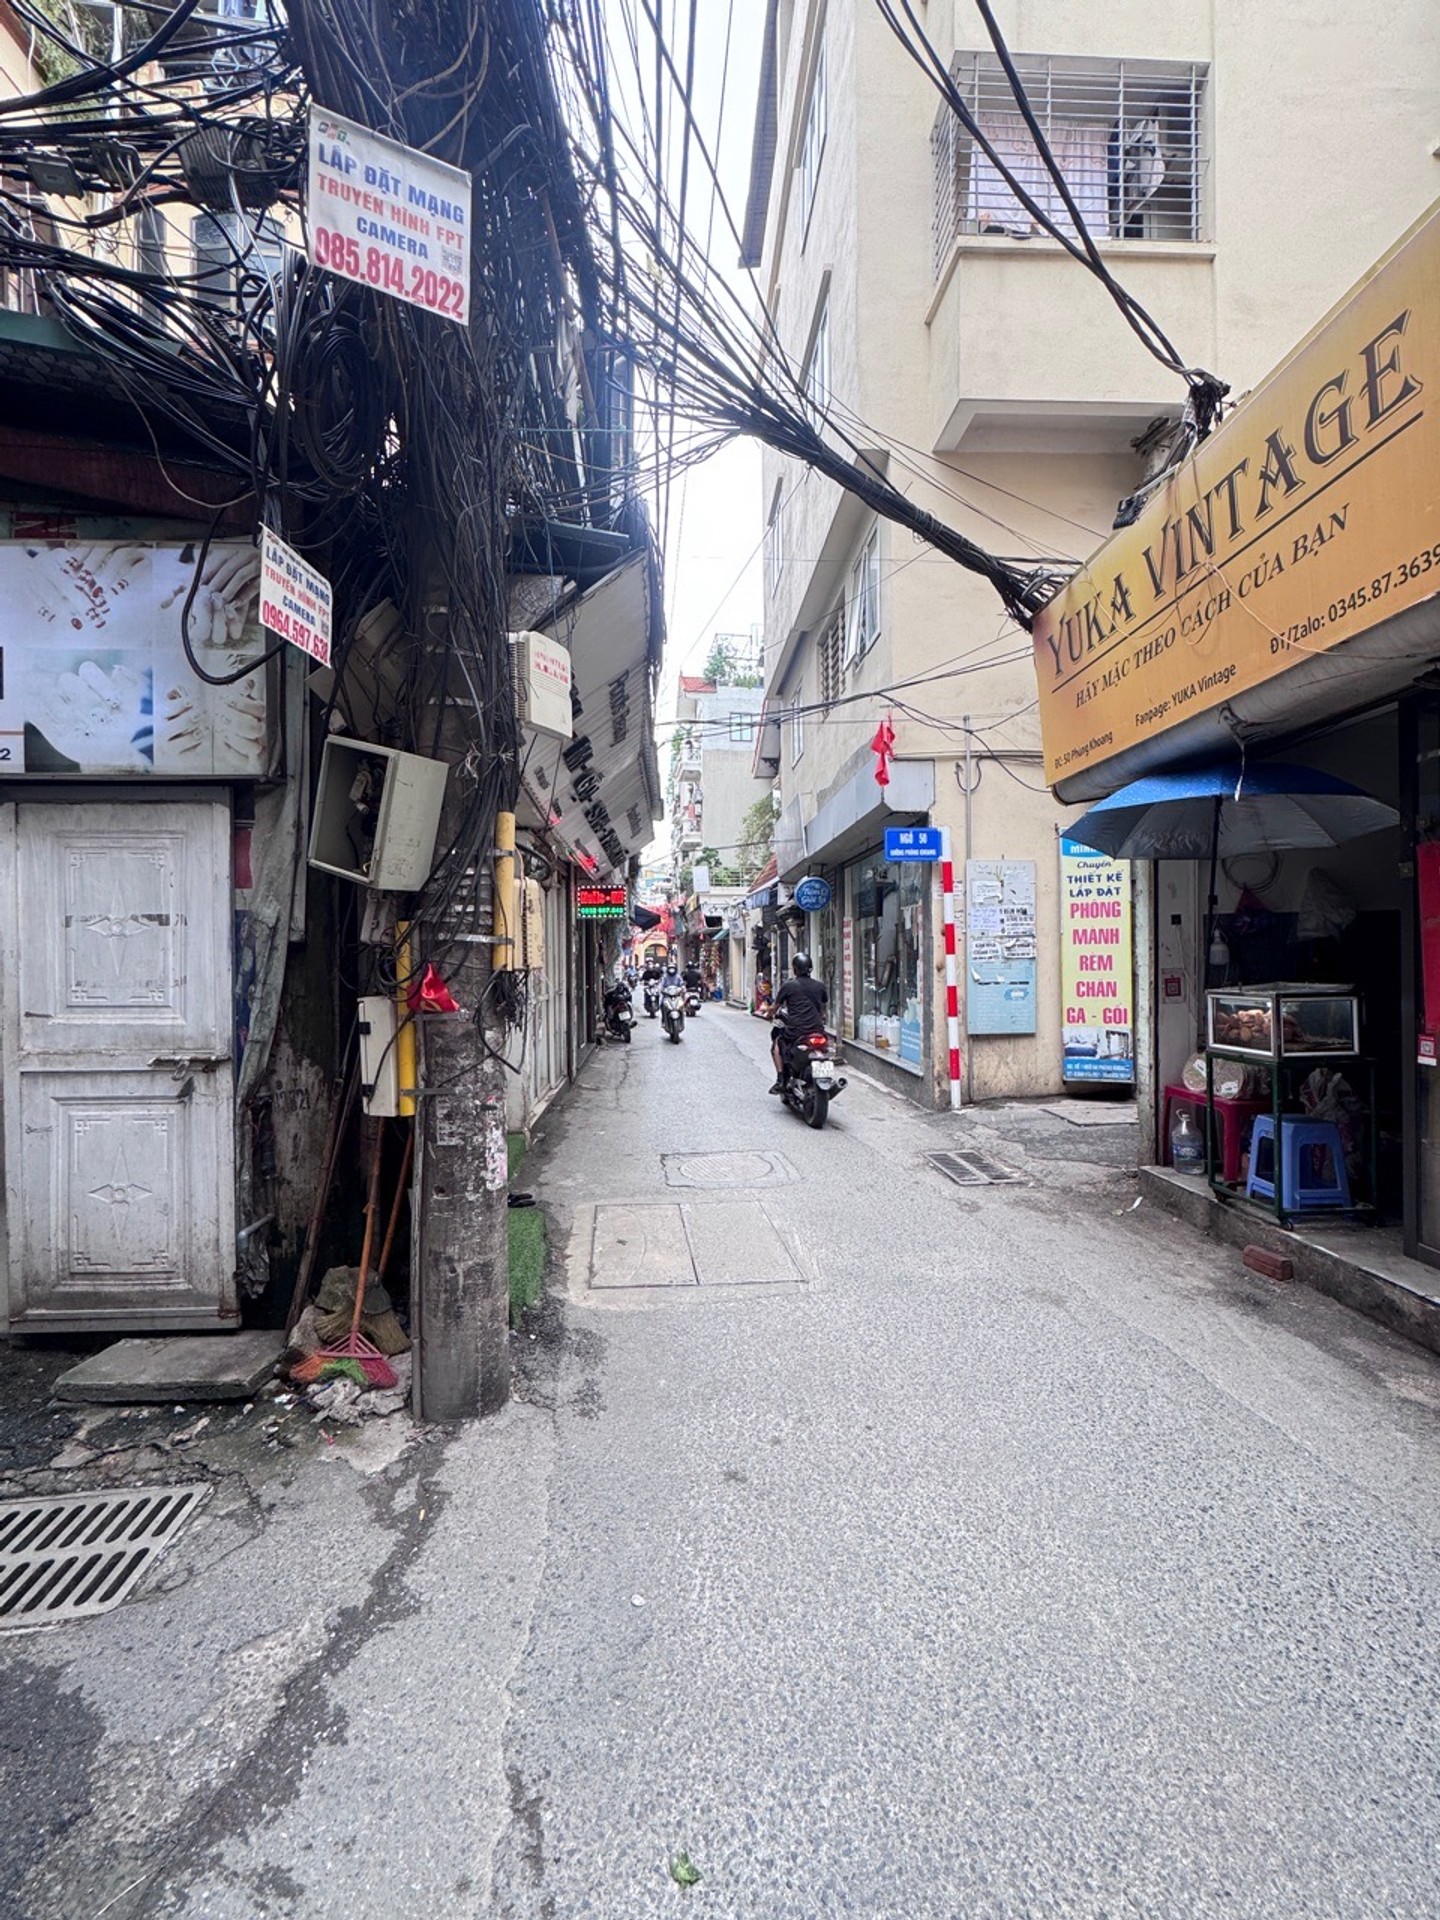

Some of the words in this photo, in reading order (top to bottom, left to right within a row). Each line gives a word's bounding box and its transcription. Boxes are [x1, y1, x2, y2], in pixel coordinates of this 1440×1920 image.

[319, 141, 357, 175] LẮP
[364, 165, 401, 197] ĐẶT
[408, 184, 465, 226] MẠNG
[356, 216, 429, 260] CAMERA
[390, 203, 430, 237] HÌNH
[436, 225, 465, 250] FPT
[315, 225, 465, 319] 085.814.2022
[1047, 573, 1136, 678] YUKA
[1142, 309, 1424, 602] VINTAGE
[282, 594, 316, 628] CAMERA
[1101, 657, 1131, 688] MẶC
[1133, 627, 1176, 671] THEO
[1179, 585, 1233, 639] CÁCH
[1238, 551, 1286, 600] CỦA
[1291, 503, 1351, 566] BẠN
[1328, 543, 1440, 623] 0345.87.3639
[1135, 700, 1172, 727] Fanpage:
[1172, 683, 1197, 707] YUKA
[1197, 664, 1237, 693] Vintage
[1066, 870, 1102, 884] THIẾT
[1106, 869, 1123, 882] KẾ
[1066, 1006, 1086, 1024] GA
[1102, 1002, 1128, 1025] GỐI
